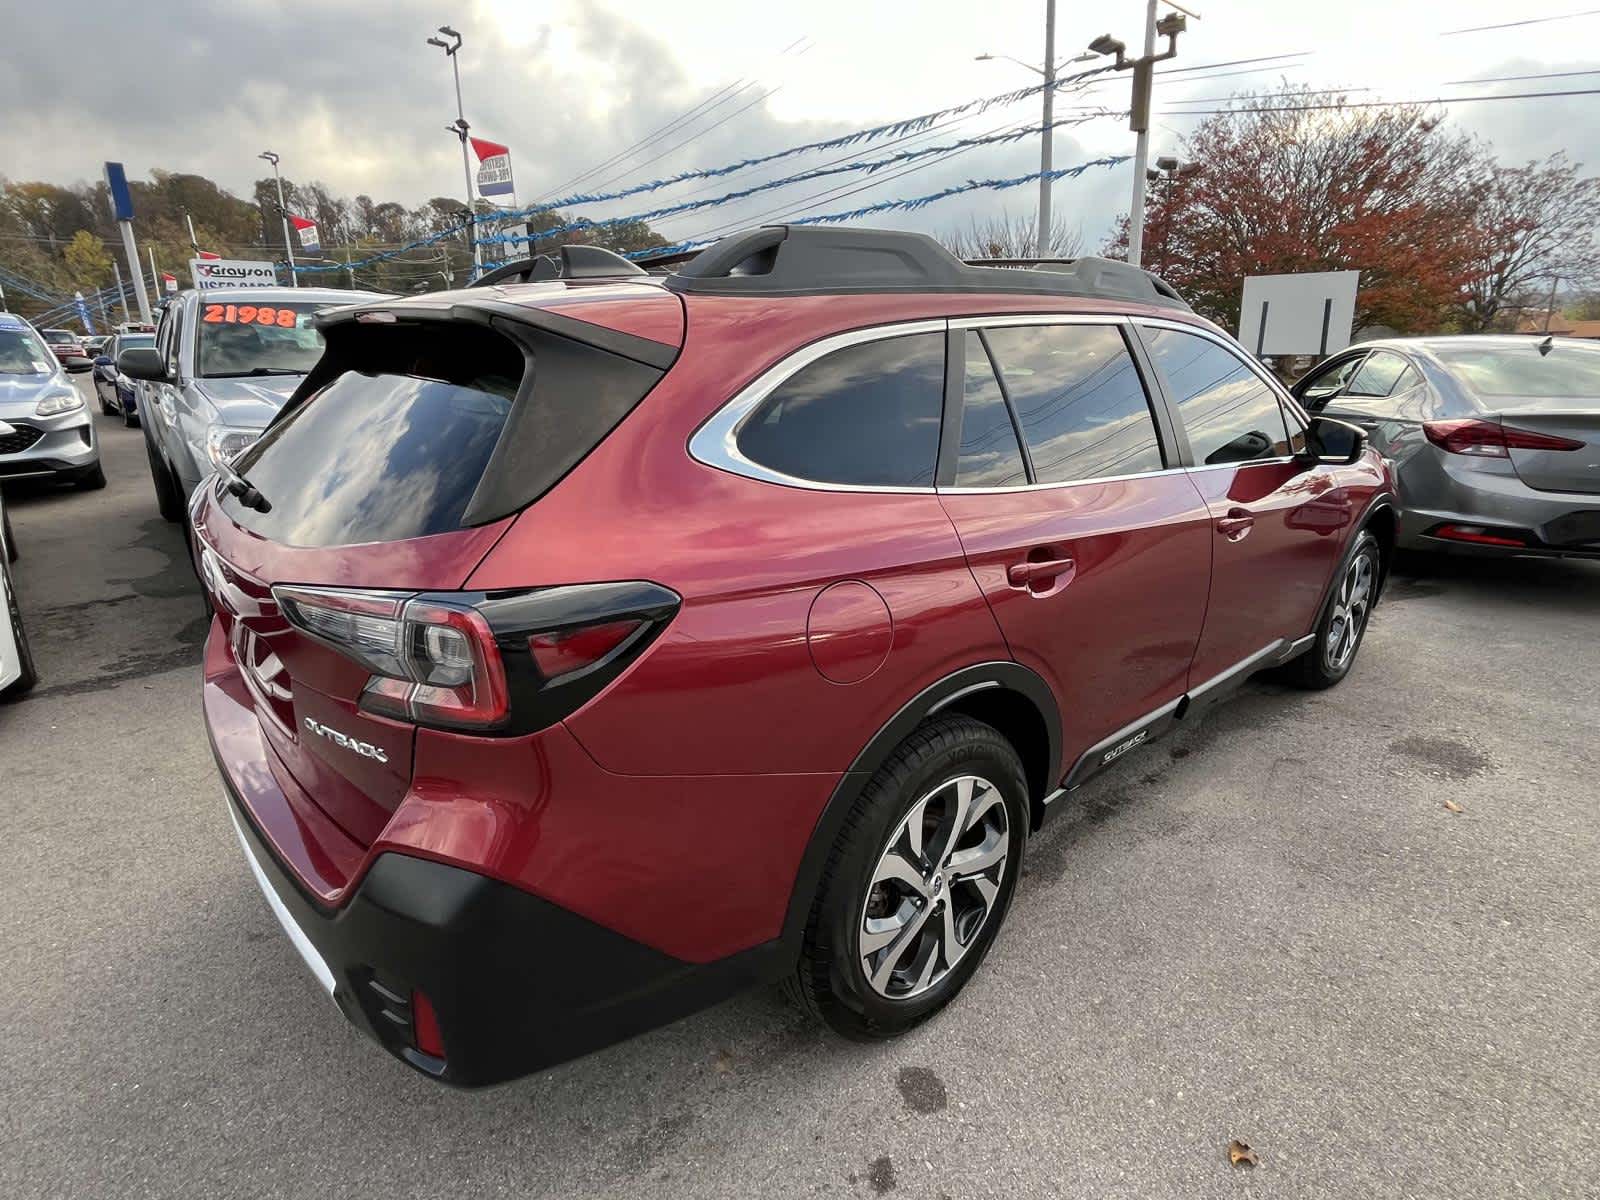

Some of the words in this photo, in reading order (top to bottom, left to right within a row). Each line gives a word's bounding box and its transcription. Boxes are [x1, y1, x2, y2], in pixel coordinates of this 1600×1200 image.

[209, 264, 272, 278] Grayson
[203, 303, 296, 328] 21988
[304, 717, 389, 763] OUTBACK
